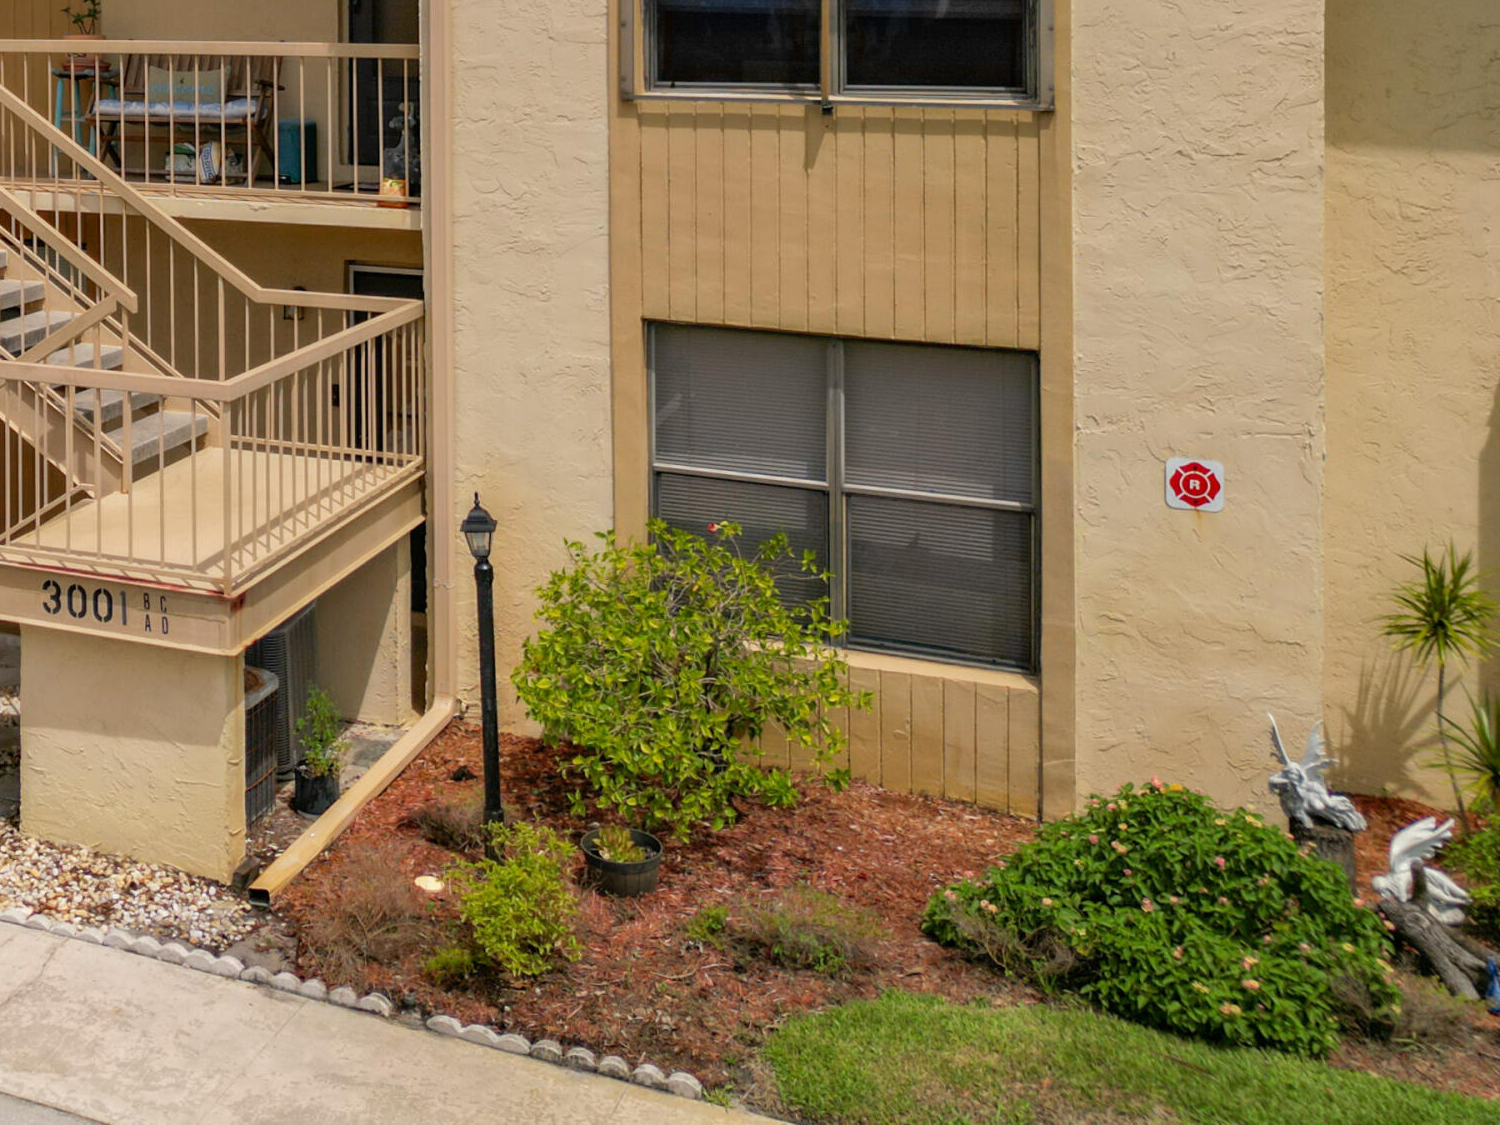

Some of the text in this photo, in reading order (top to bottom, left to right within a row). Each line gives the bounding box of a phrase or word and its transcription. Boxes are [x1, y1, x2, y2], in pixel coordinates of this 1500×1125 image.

[1189, 479, 1201, 490] R
[42, 579, 127, 626] 3001
[143, 592, 167, 613] B C
[145, 614, 169, 635] A D
